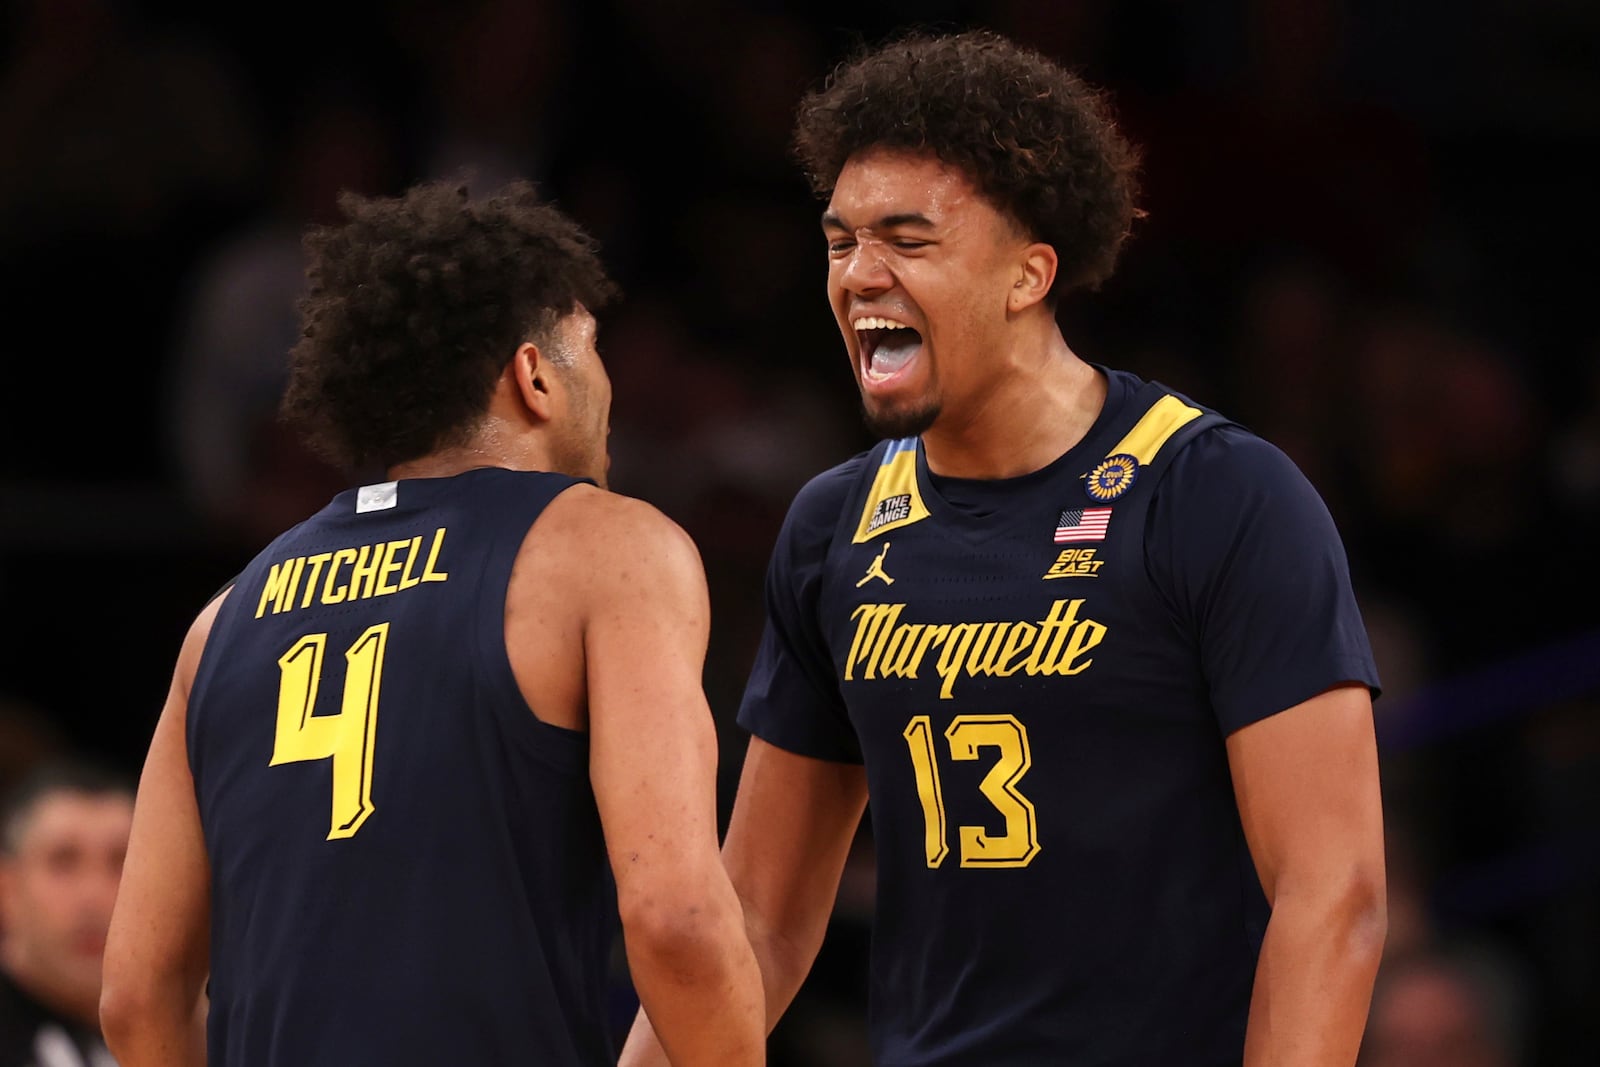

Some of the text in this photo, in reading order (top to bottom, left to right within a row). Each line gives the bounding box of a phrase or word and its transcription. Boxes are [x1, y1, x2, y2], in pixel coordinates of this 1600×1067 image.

[885, 495, 909, 511] THE
[255, 528, 447, 619] MITCHELL
[1048, 561, 1104, 574] EAST
[1056, 549, 1097, 562] BIG
[845, 599, 1107, 699] Marquette
[269, 623, 389, 840] 4
[903, 714, 1041, 868] 13
